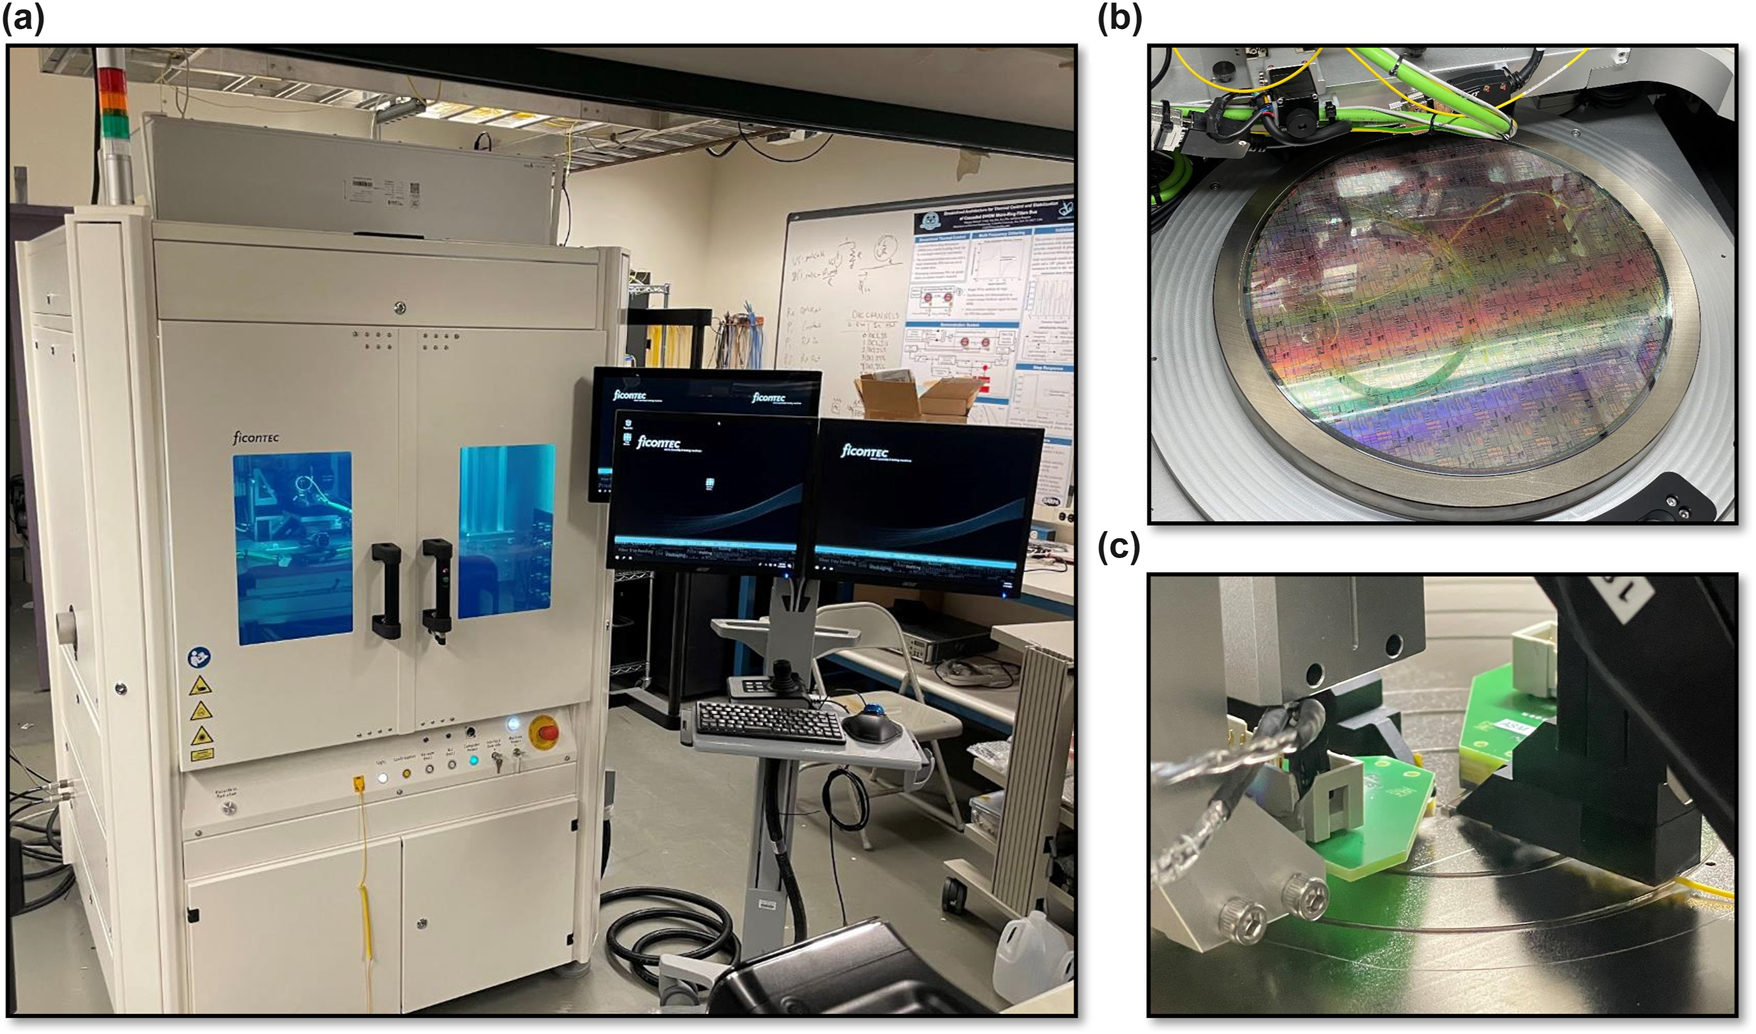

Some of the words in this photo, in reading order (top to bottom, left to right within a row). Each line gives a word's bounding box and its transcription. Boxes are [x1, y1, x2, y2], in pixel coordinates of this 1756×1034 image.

[232, 430, 280, 446] ficonTEC
[636, 434, 681, 450] ficonTEC
[840, 443, 889, 458] ficonTEC
